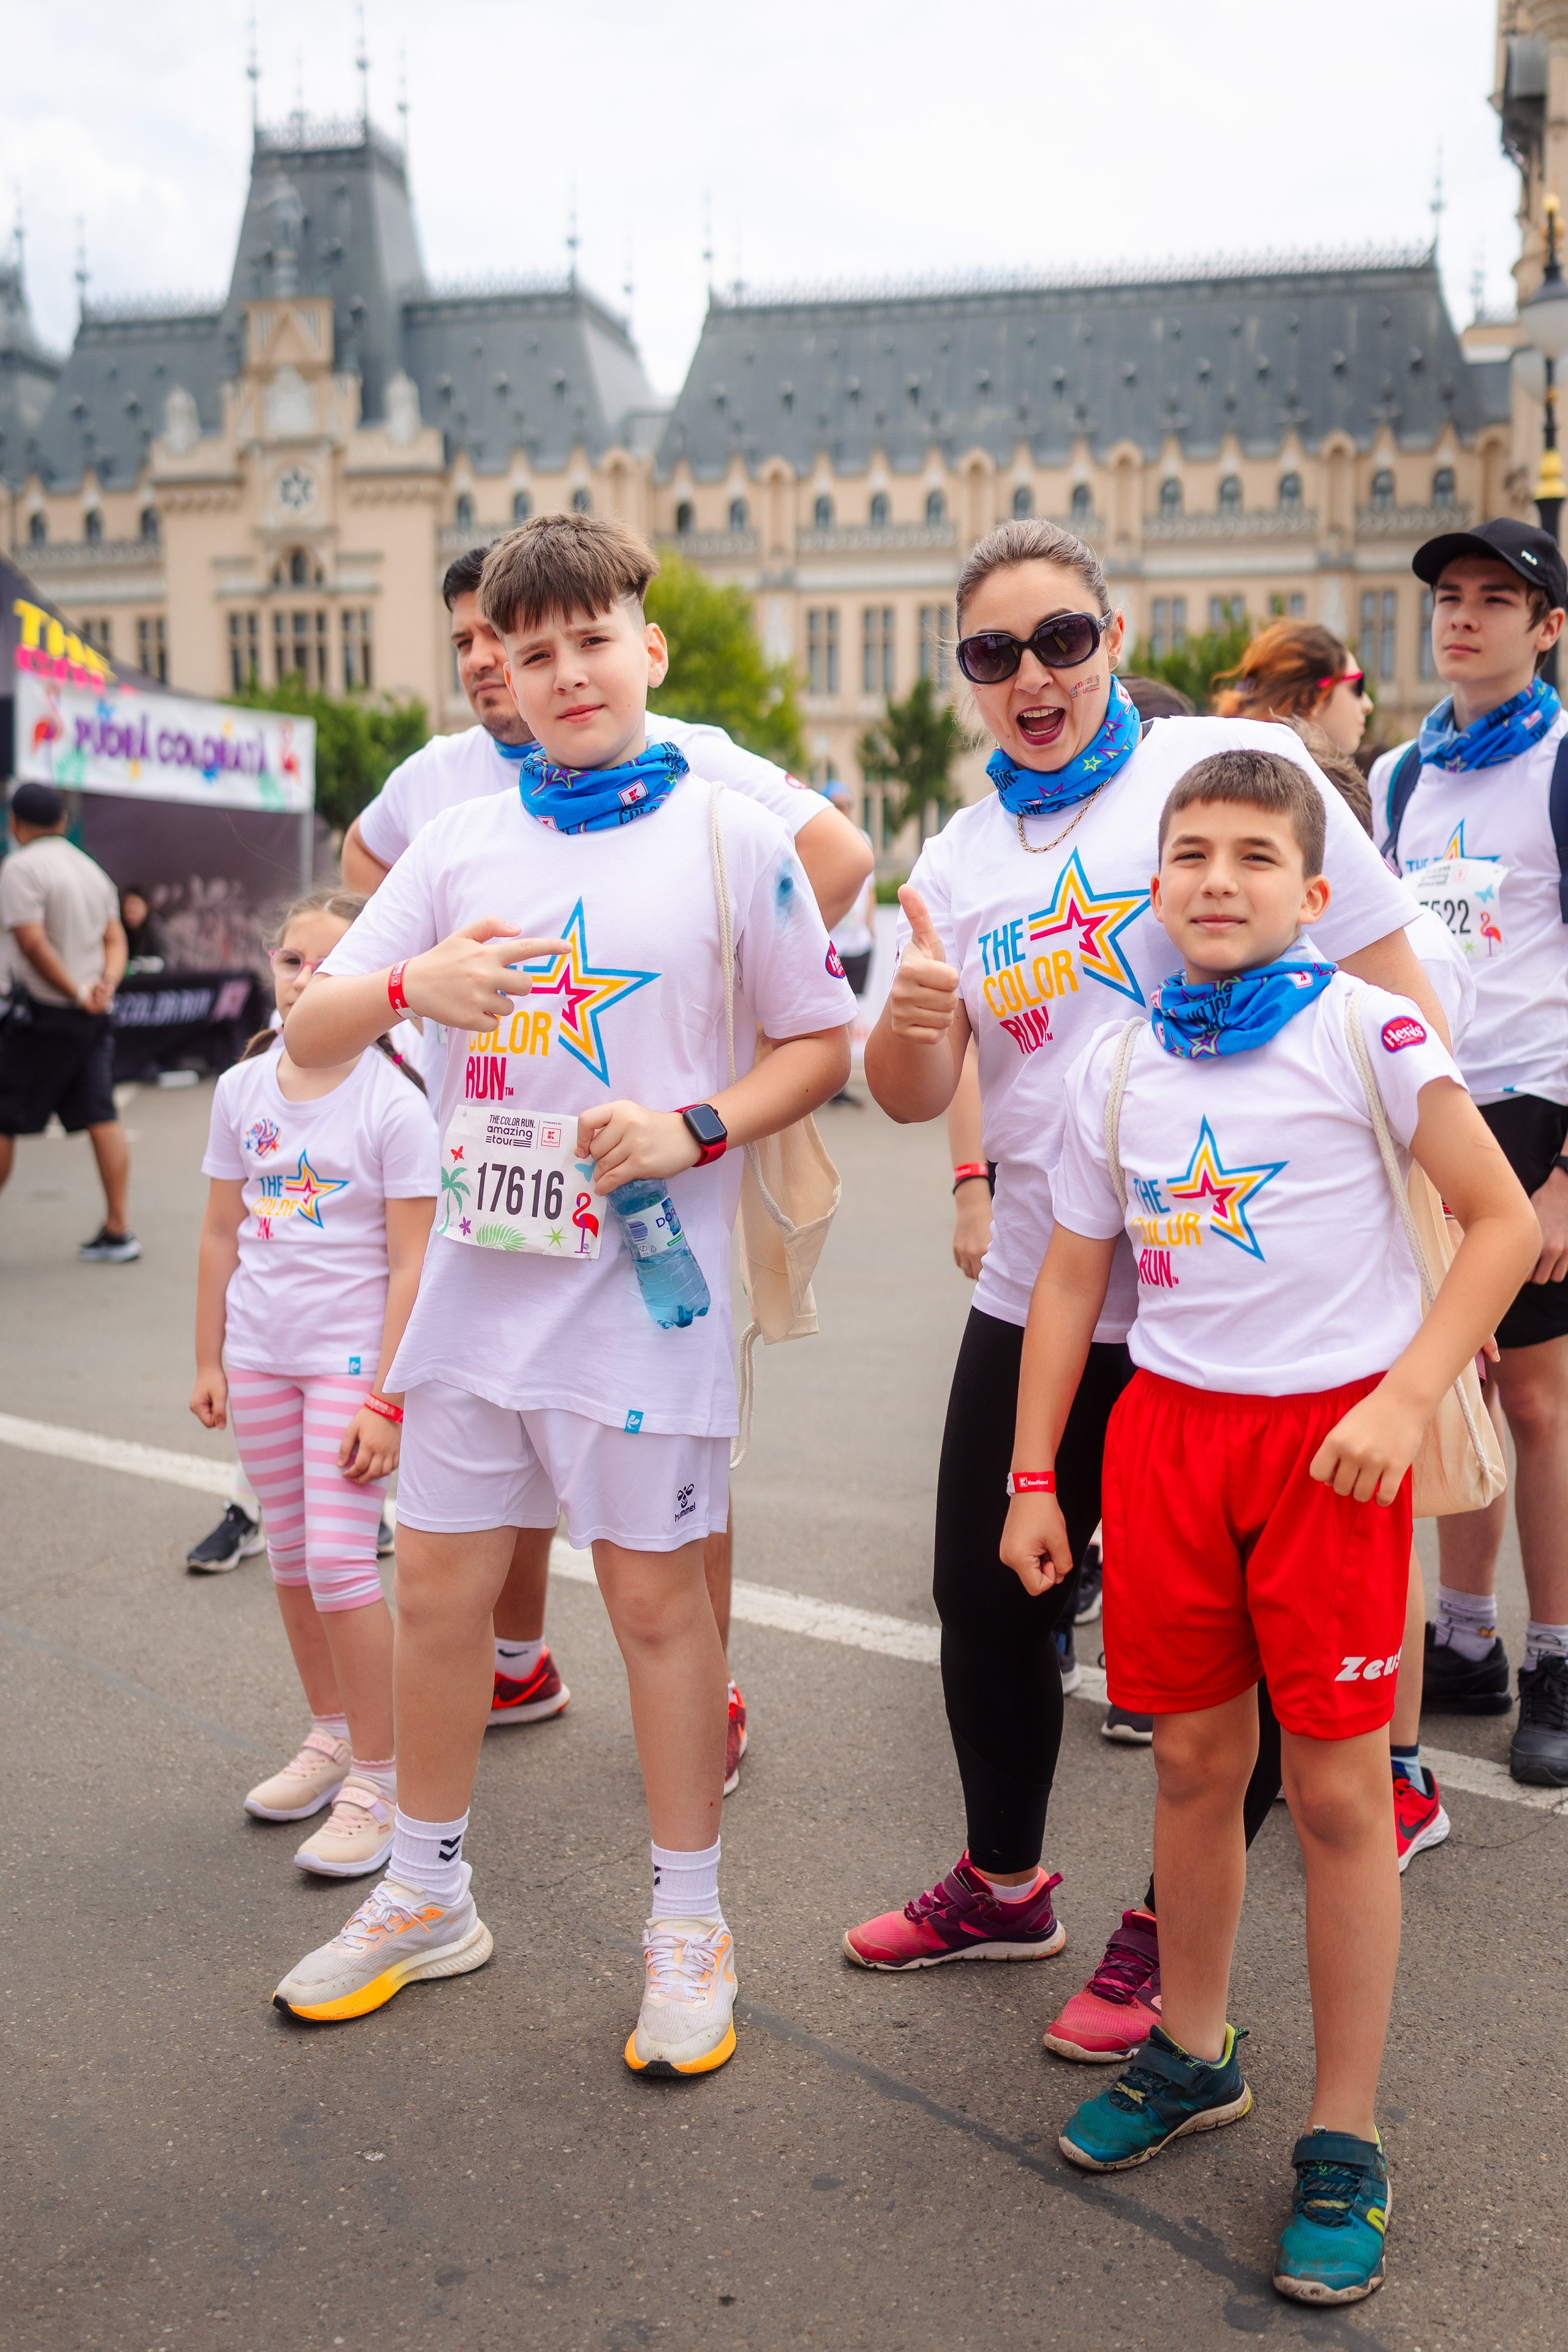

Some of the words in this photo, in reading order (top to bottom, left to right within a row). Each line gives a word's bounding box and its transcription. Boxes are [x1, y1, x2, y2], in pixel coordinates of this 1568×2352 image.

[978, 918, 1026, 976] THE
[983, 949, 1079, 1018] COLOR
[489, 1115, 500, 1125] THE
[500, 1116, 520, 1127] COLOR
[487, 1125, 533, 1140] amazing
[492, 1134, 513, 1145] tour
[257, 1175, 283, 1197] THE
[477, 1162, 564, 1220] 17616
[1133, 1177, 1170, 1215] THE
[252, 1197, 299, 1218] COLOR
[674, 1501, 696, 1523] hummel
